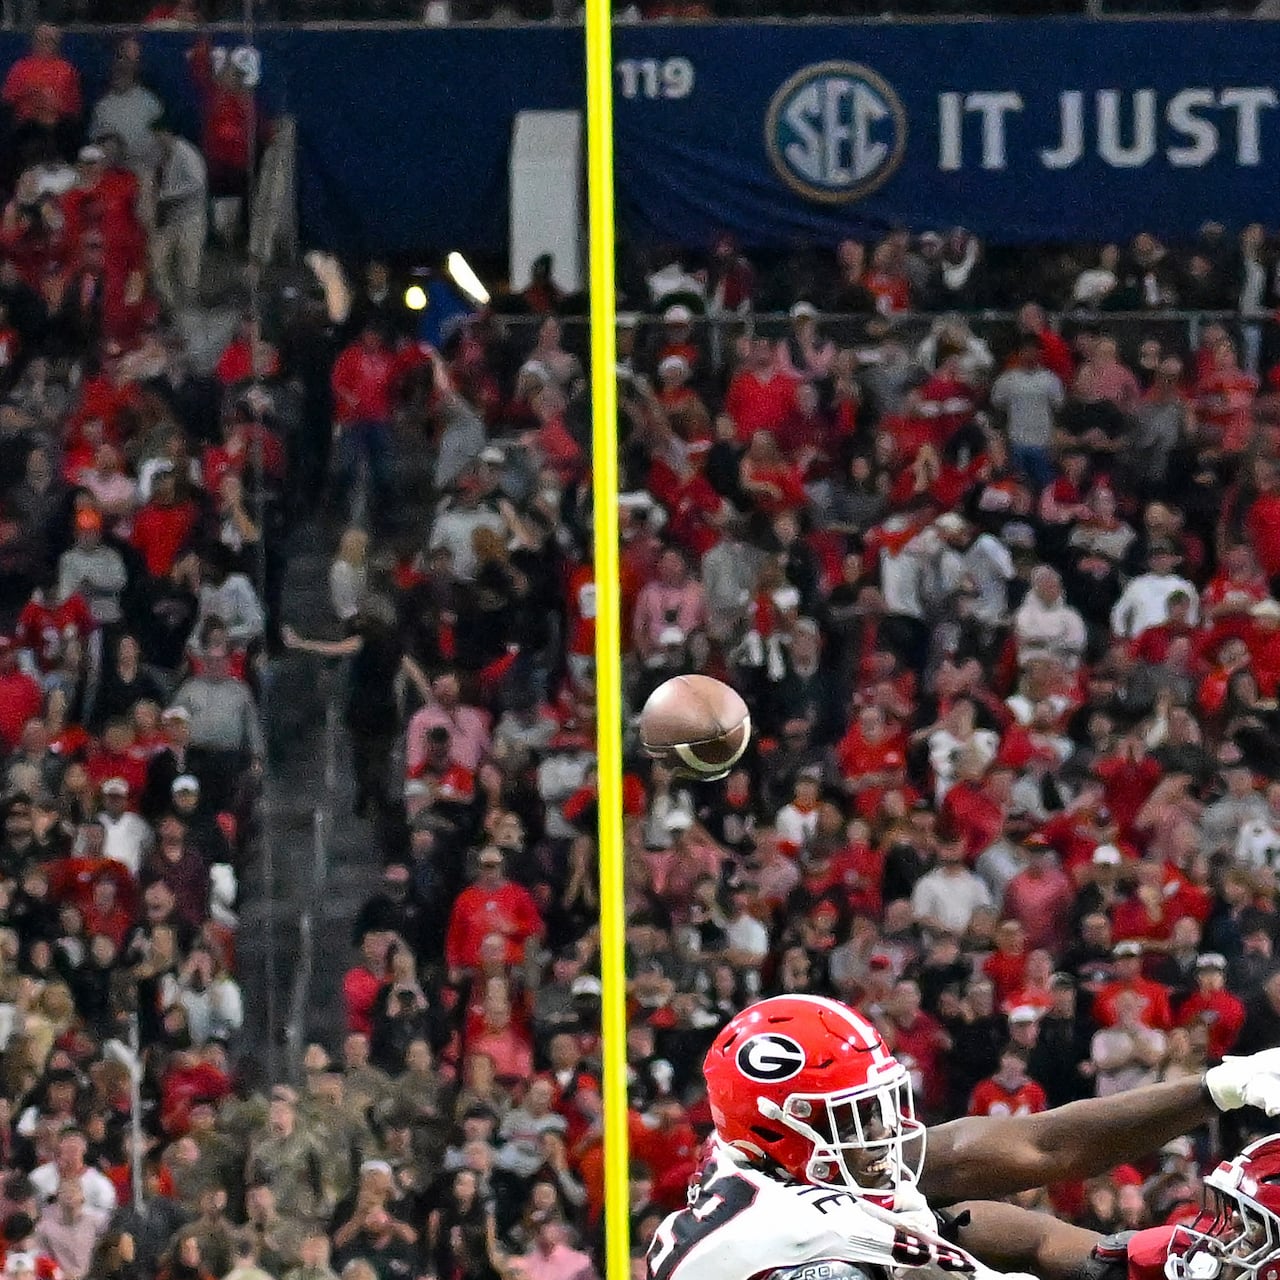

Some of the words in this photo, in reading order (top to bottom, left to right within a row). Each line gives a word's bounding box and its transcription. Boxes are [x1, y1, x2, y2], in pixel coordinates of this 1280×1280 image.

[616, 57, 695, 98] 119
[780, 78, 890, 185] SEC
[938, 92, 1023, 171] IT
[1041, 88, 1279, 169] JUST
[737, 1034, 805, 1083] G
